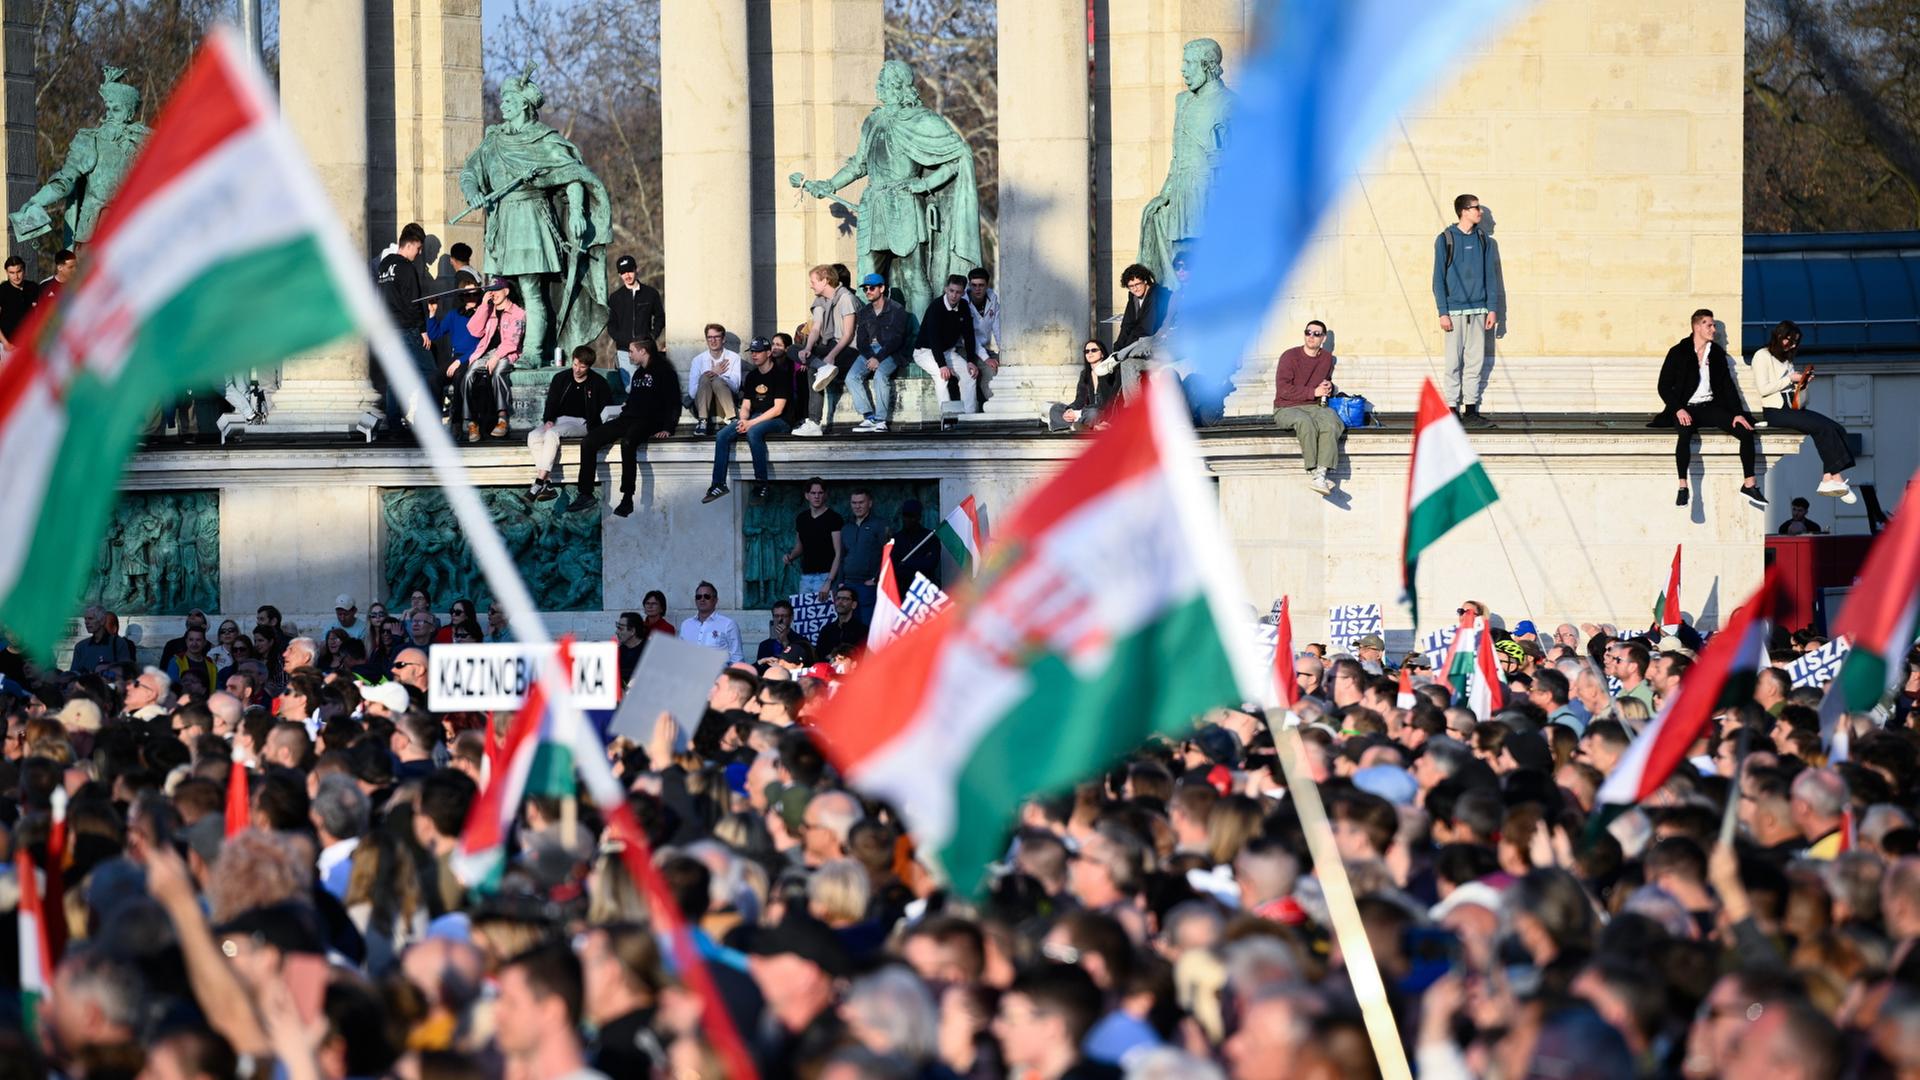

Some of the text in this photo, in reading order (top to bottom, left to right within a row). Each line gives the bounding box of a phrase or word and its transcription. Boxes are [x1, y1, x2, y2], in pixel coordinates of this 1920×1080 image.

[909, 571, 955, 613] TISZ
[1330, 604, 1380, 620] TISZA
[1331, 619, 1382, 636] TISZA
[1782, 635, 1851, 682] TISZA
